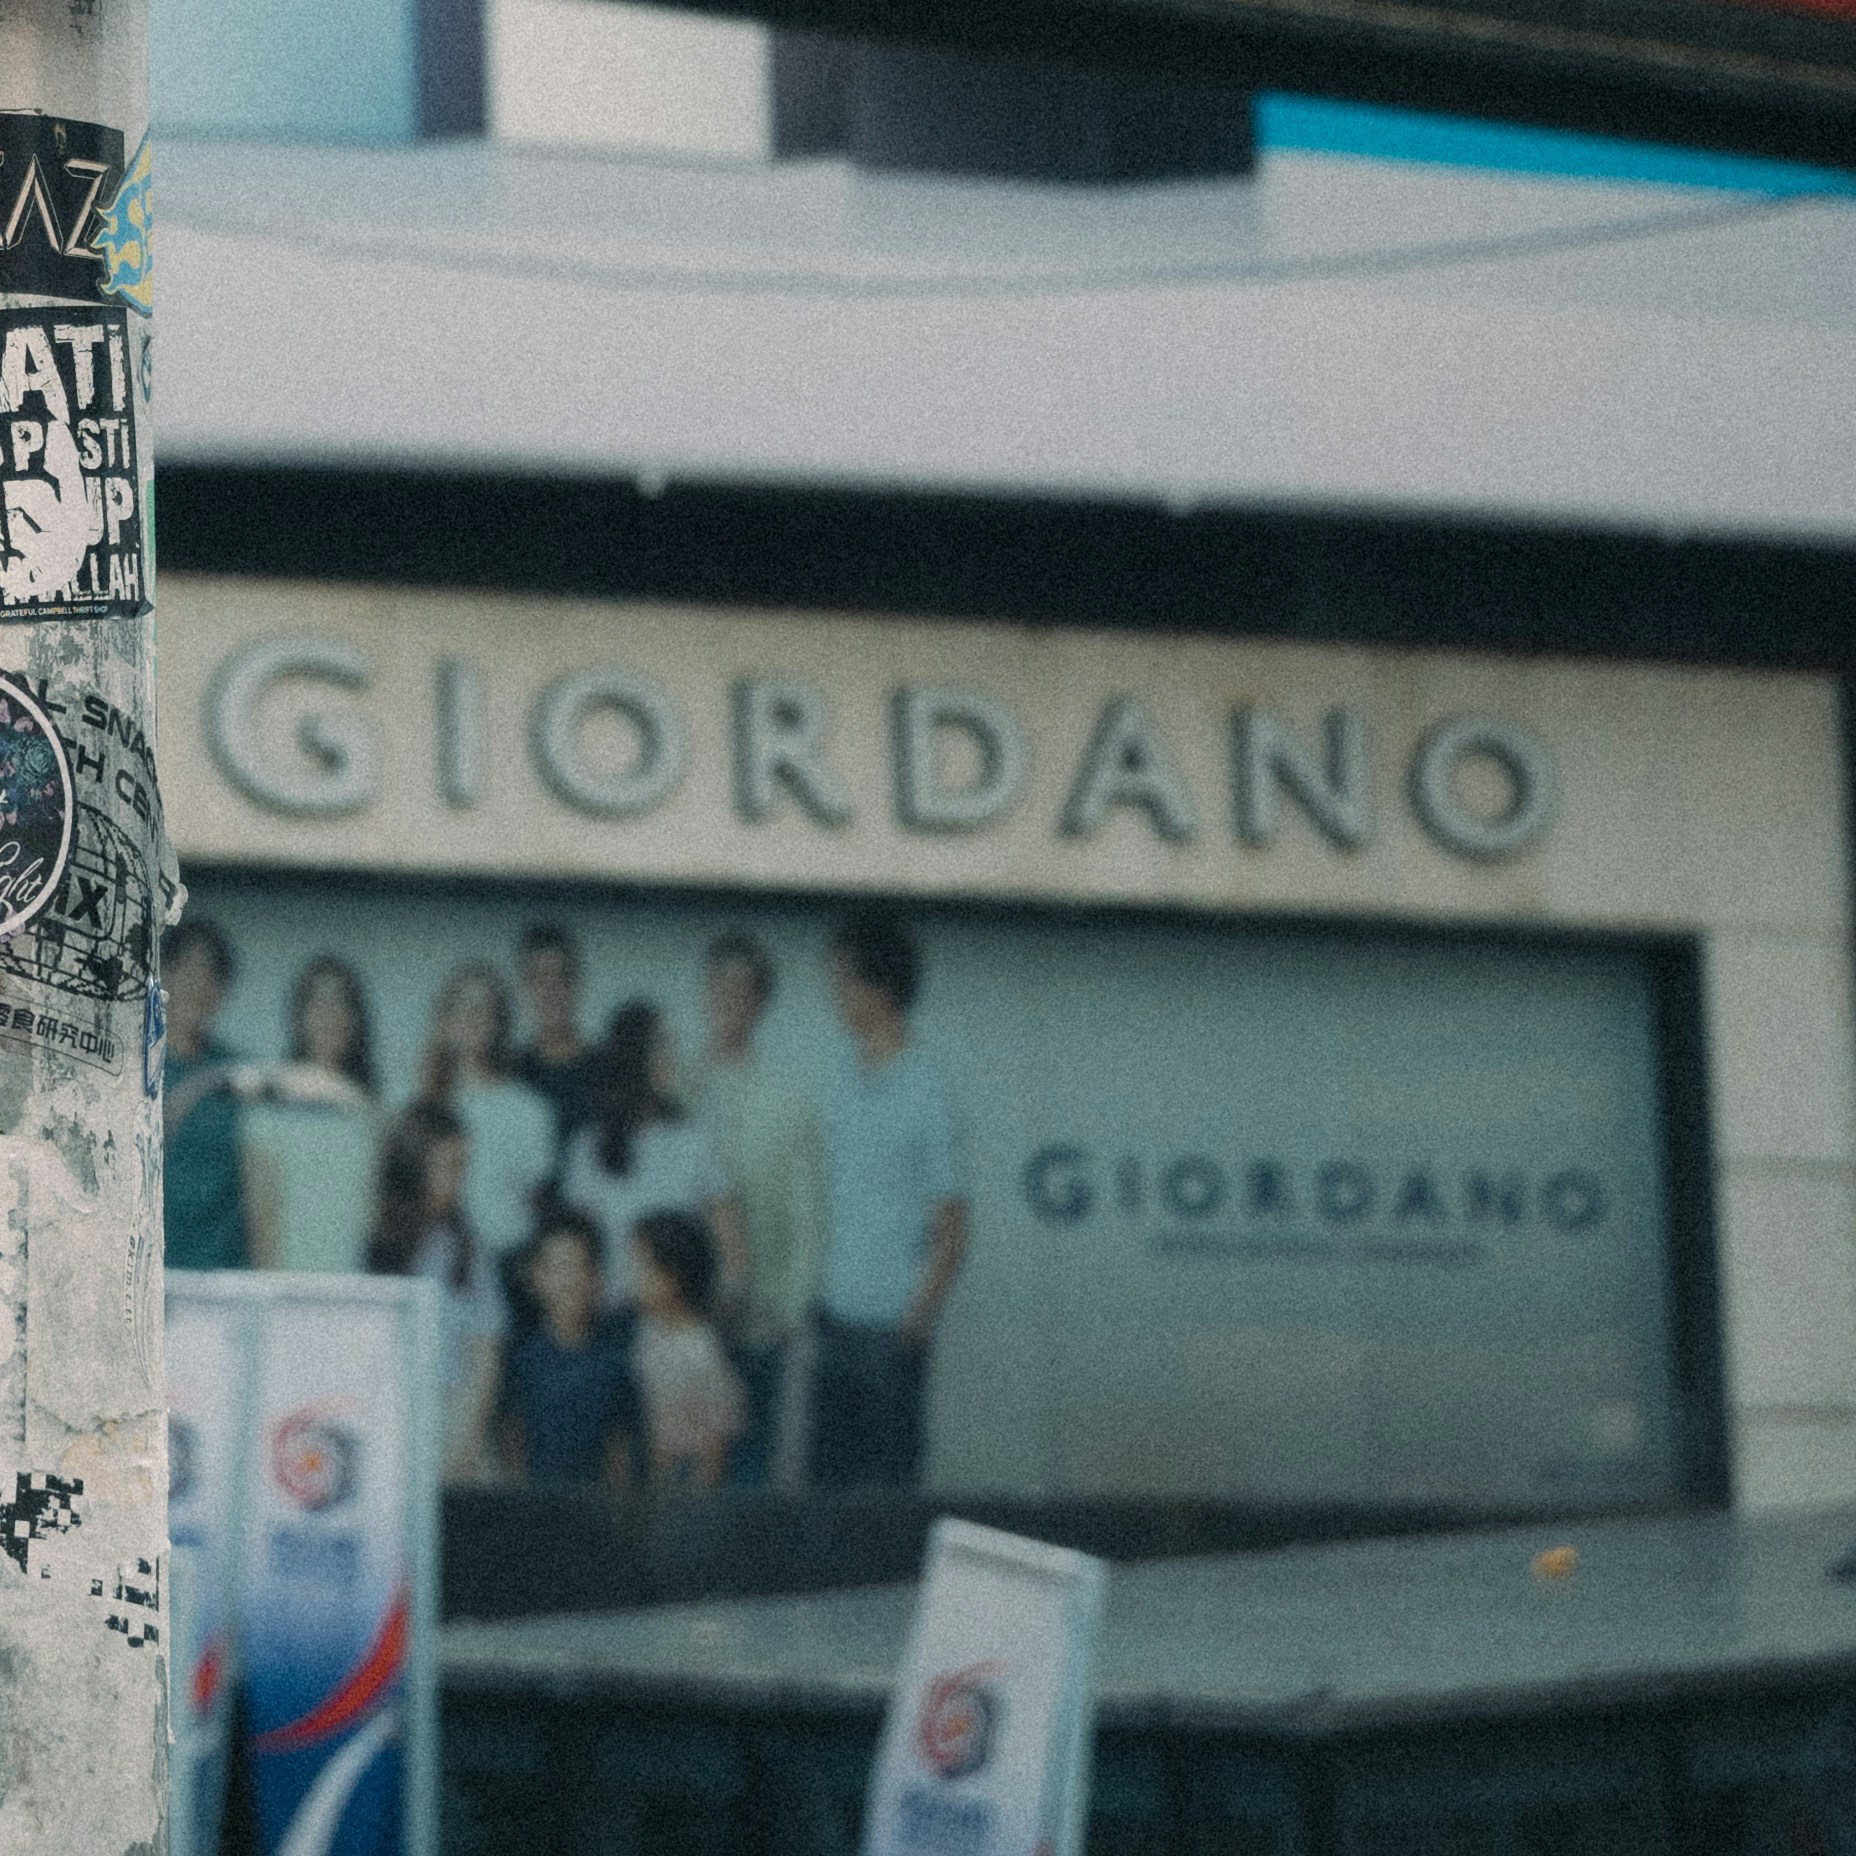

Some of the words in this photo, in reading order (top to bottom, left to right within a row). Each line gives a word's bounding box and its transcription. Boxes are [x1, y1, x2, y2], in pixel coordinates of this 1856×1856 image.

[10, 418, 131, 472] PSTI
[0, 608, 38, 618] GRATEFUL
[38, 606, 73, 616] CAMPBELL
[202, 623, 1554, 866] GIORDANO
[1020, 1140, 1611, 1236] GIORDANO
